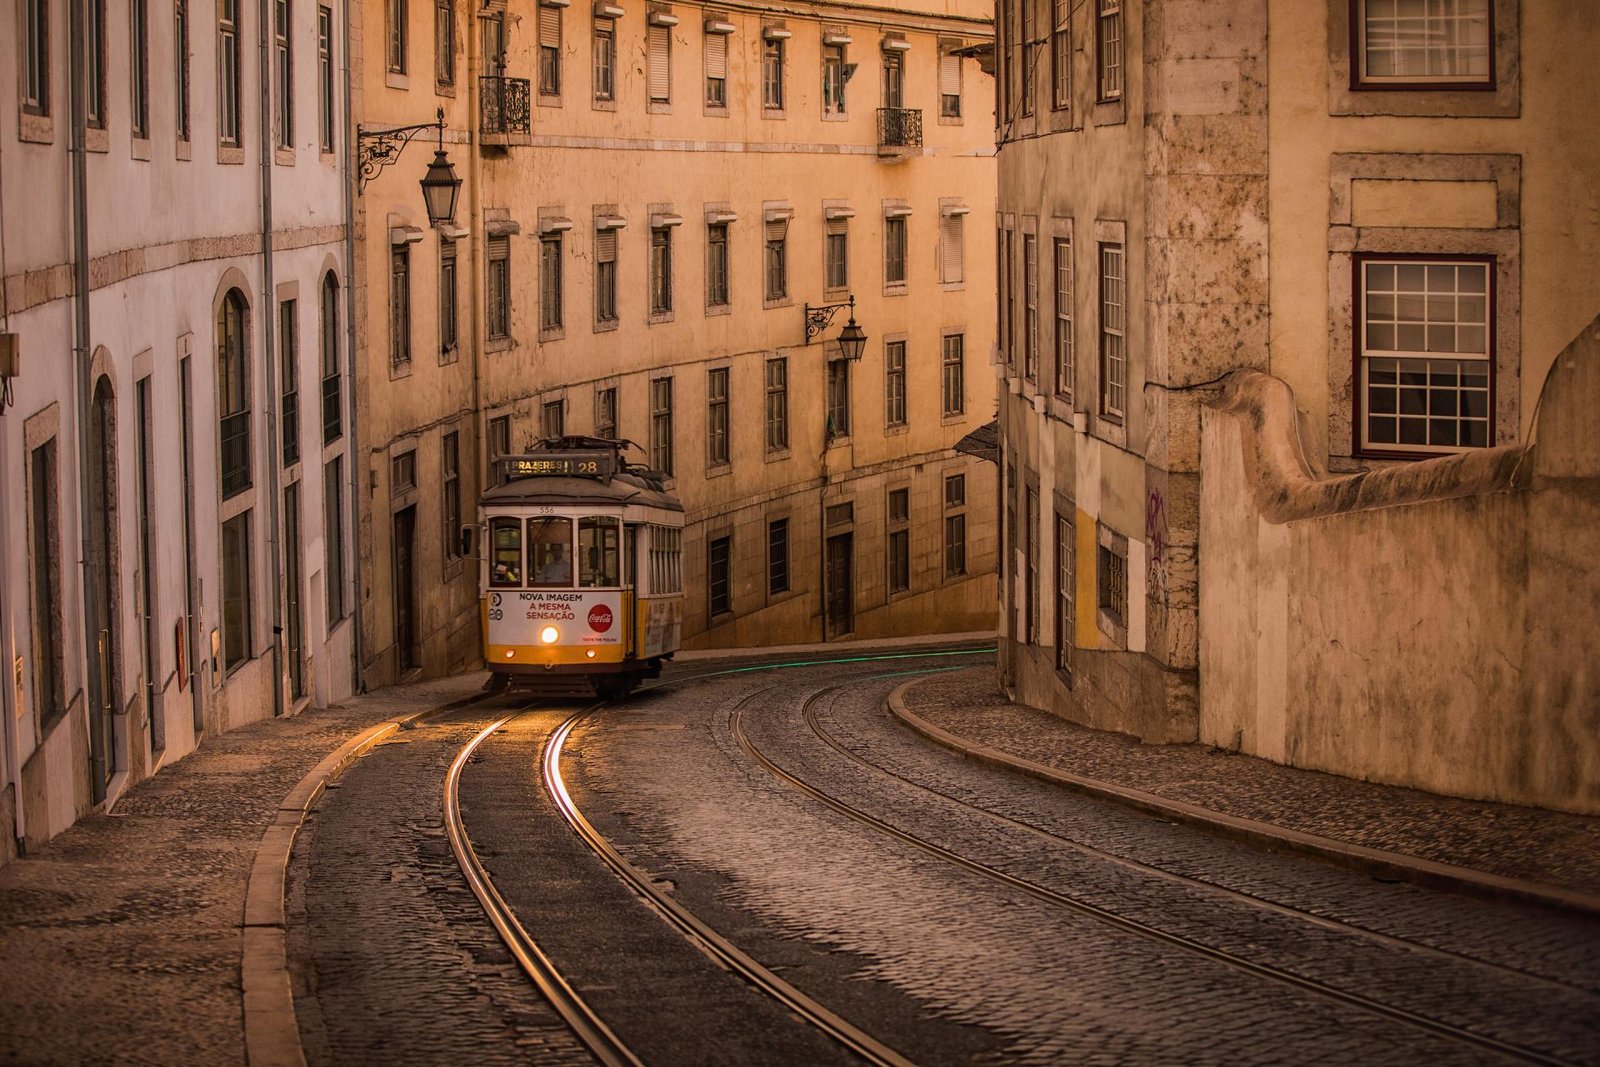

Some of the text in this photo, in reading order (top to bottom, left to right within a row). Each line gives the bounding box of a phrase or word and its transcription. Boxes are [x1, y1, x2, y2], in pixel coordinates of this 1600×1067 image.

[512, 461, 597, 473] PRAZERES 28
[520, 593, 544, 601] NOVA
[526, 611, 575, 621] SENSAÇÃO
